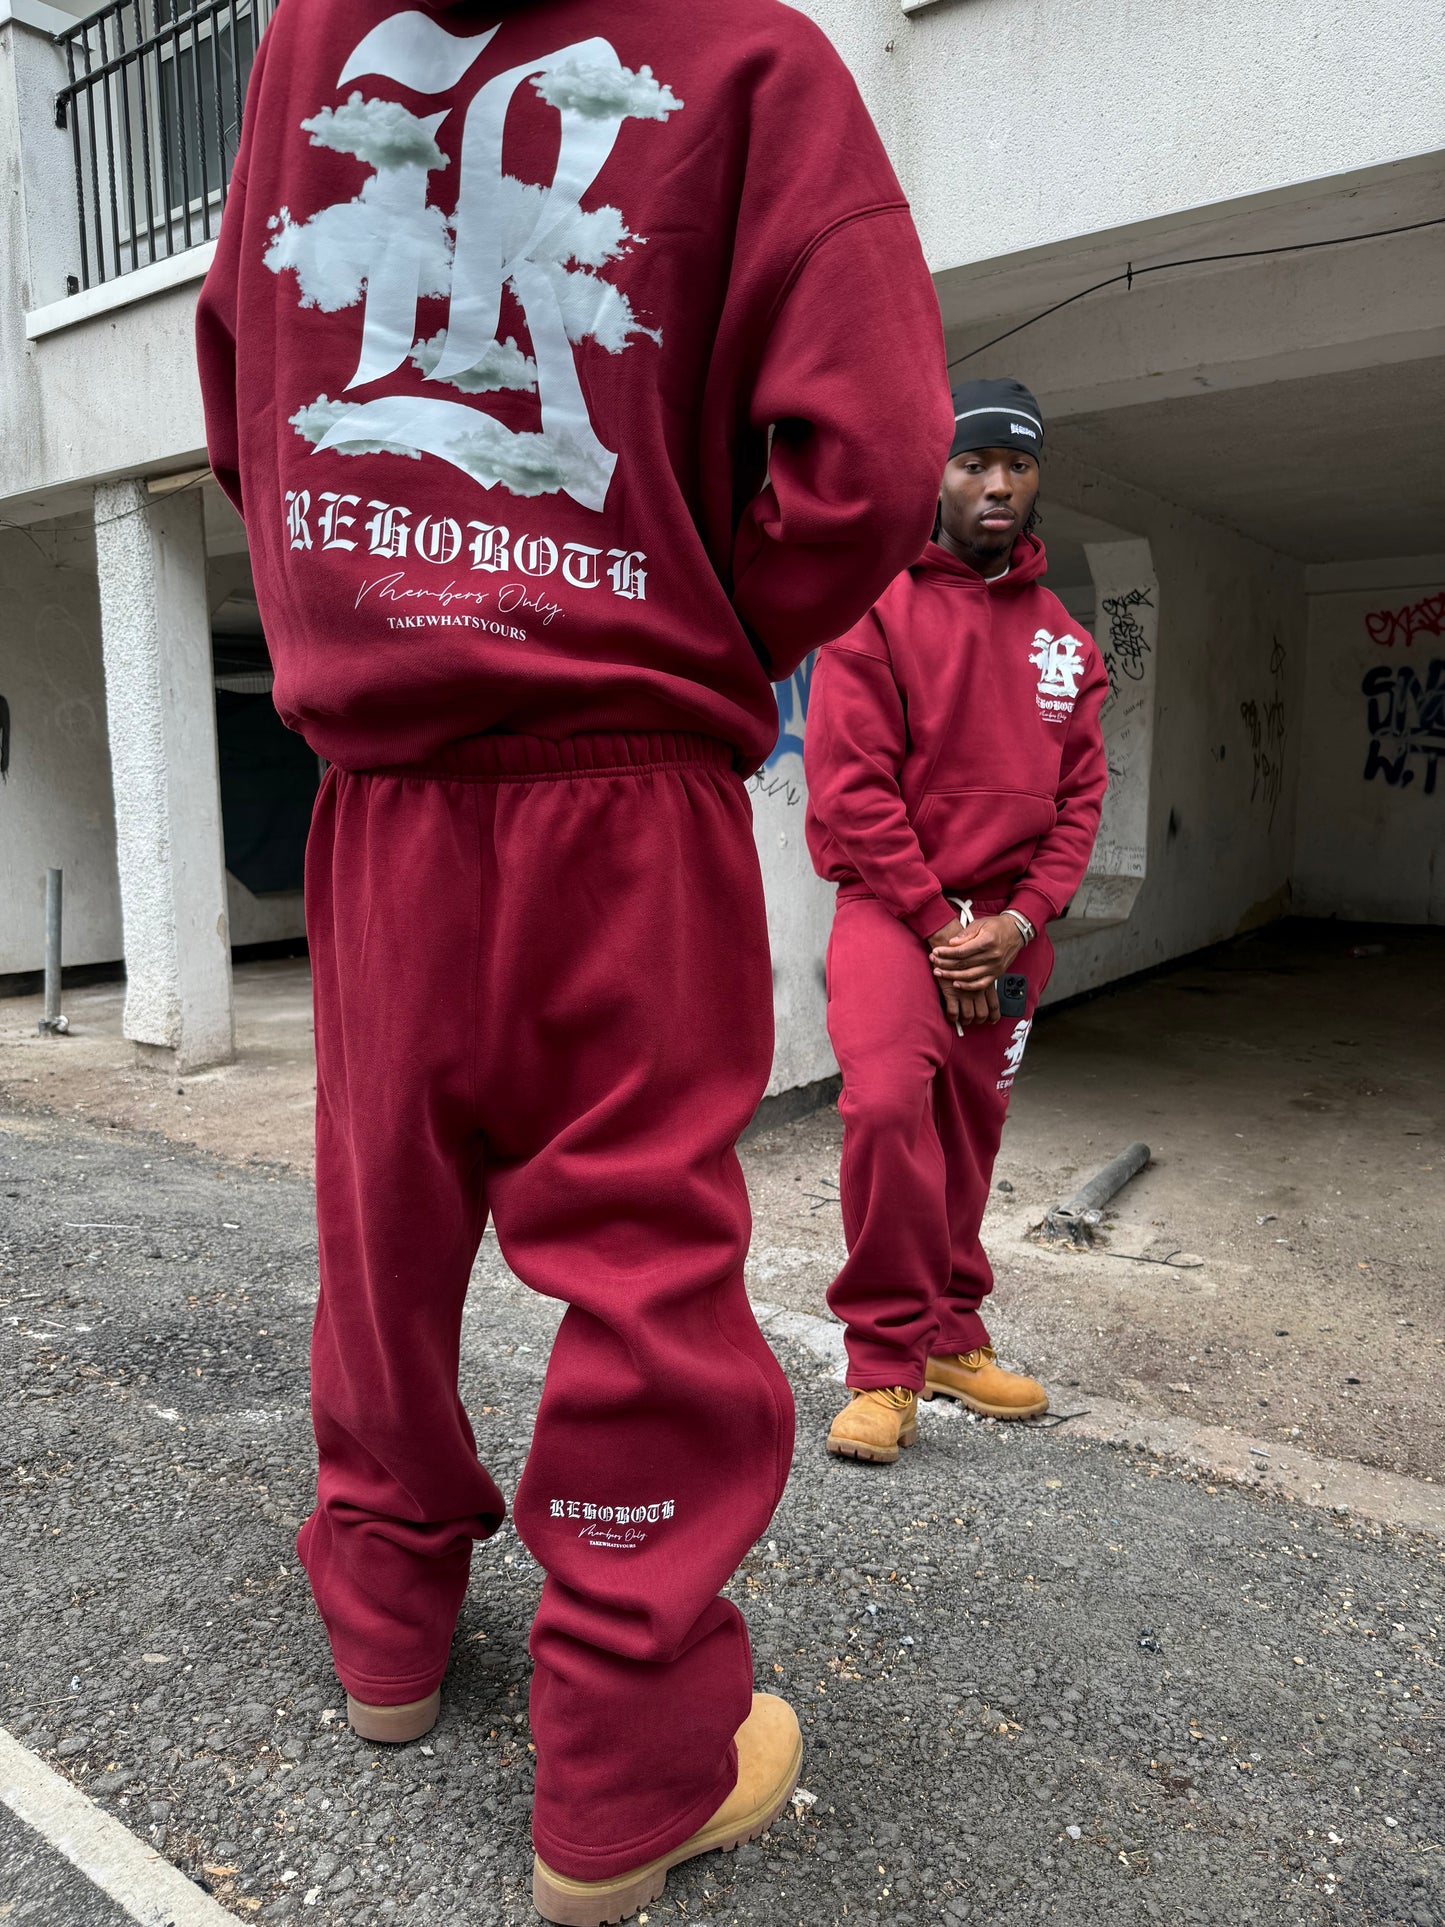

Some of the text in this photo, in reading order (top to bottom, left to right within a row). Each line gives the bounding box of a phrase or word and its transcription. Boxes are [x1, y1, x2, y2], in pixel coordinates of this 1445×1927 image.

[285, 489, 648, 600] REHOBOTH
[354, 571, 489, 609] Members
[387, 615, 527, 641] TAKEWHATSYOURS
[550, 1499, 675, 1525] REHOBOTH
[578, 1524, 622, 1540] Members
